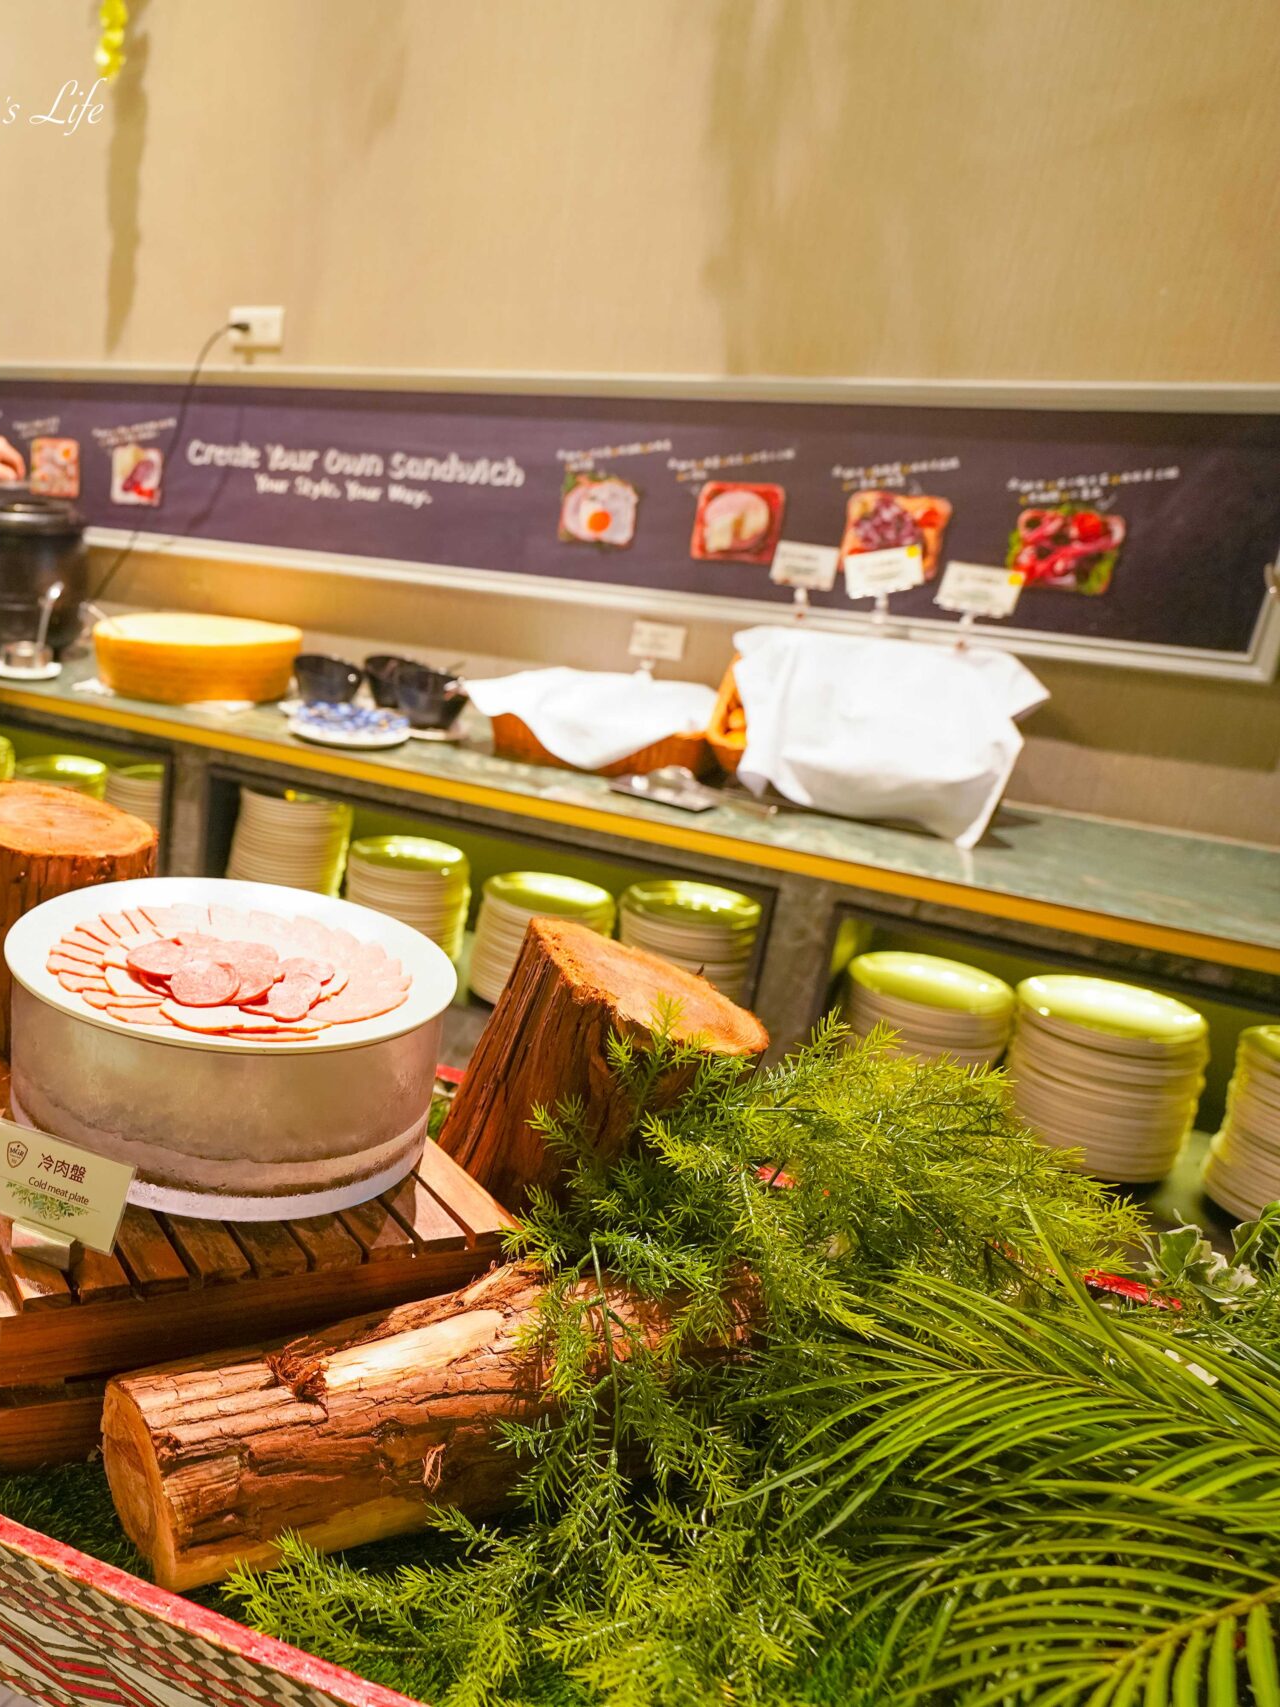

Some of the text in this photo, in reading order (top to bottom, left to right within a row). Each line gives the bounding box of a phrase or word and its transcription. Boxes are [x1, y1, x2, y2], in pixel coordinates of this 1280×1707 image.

[186, 438, 261, 469] Create
[265, 443, 320, 472] Your
[323, 448, 384, 478] Own
[389, 452, 525, 487] Sandwich
[254, 473, 289, 494] Your
[345, 480, 383, 502] Your
[37, 1153, 86, 1183] 冷肉盤
[28, 1176, 89, 1205] Cold meat plate
